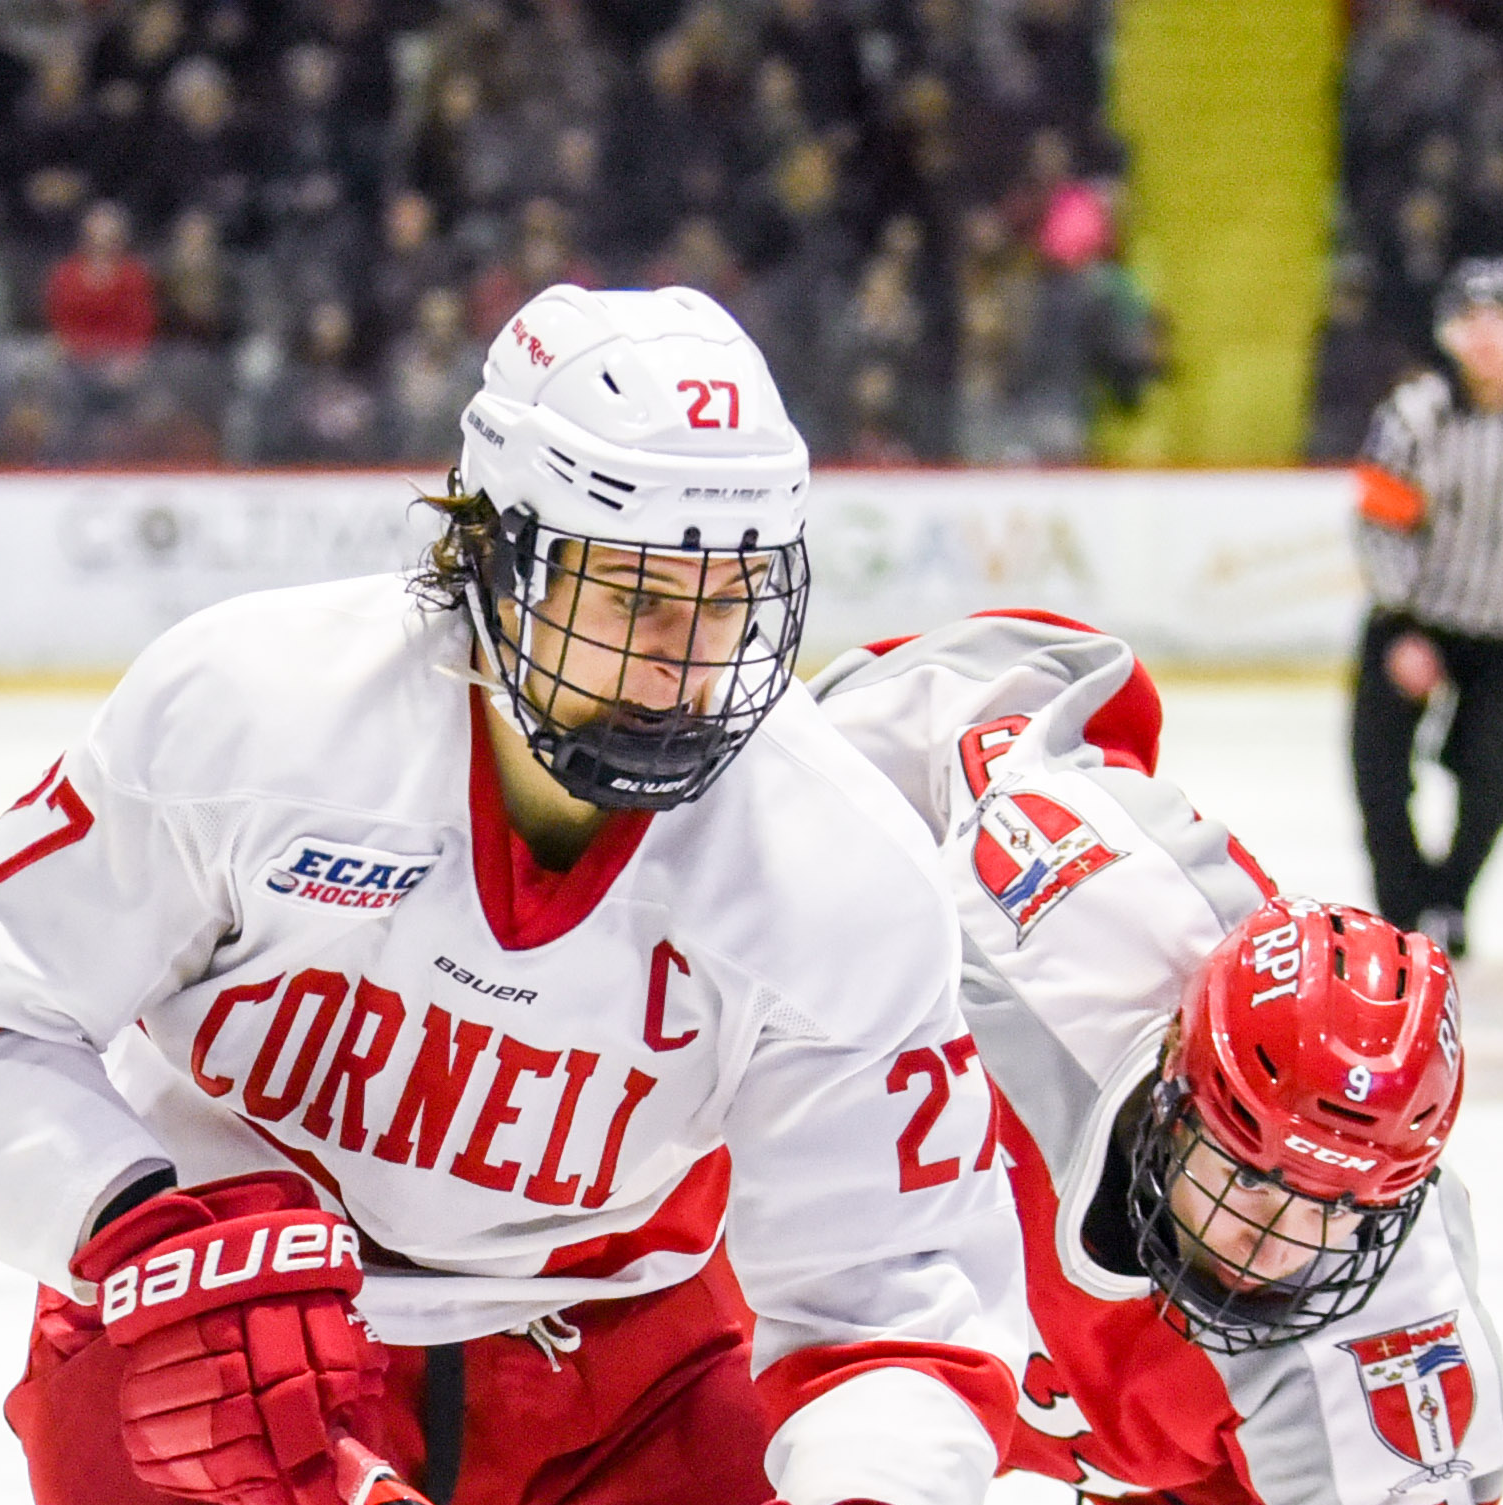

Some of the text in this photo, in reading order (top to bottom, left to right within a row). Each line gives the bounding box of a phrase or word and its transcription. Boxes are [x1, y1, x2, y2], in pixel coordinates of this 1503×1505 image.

[528, 336, 556, 368] Red
[677, 379, 739, 429] 27
[433, 956, 538, 1005] BAUER
[1251, 921, 1301, 1008] RPI
[643, 939, 700, 1052] C
[1344, 1065, 1373, 1102] 9
[886, 1032, 999, 1193] 27
[1284, 1134, 1377, 1172] CCM
[102, 1223, 363, 1326] BAUER
